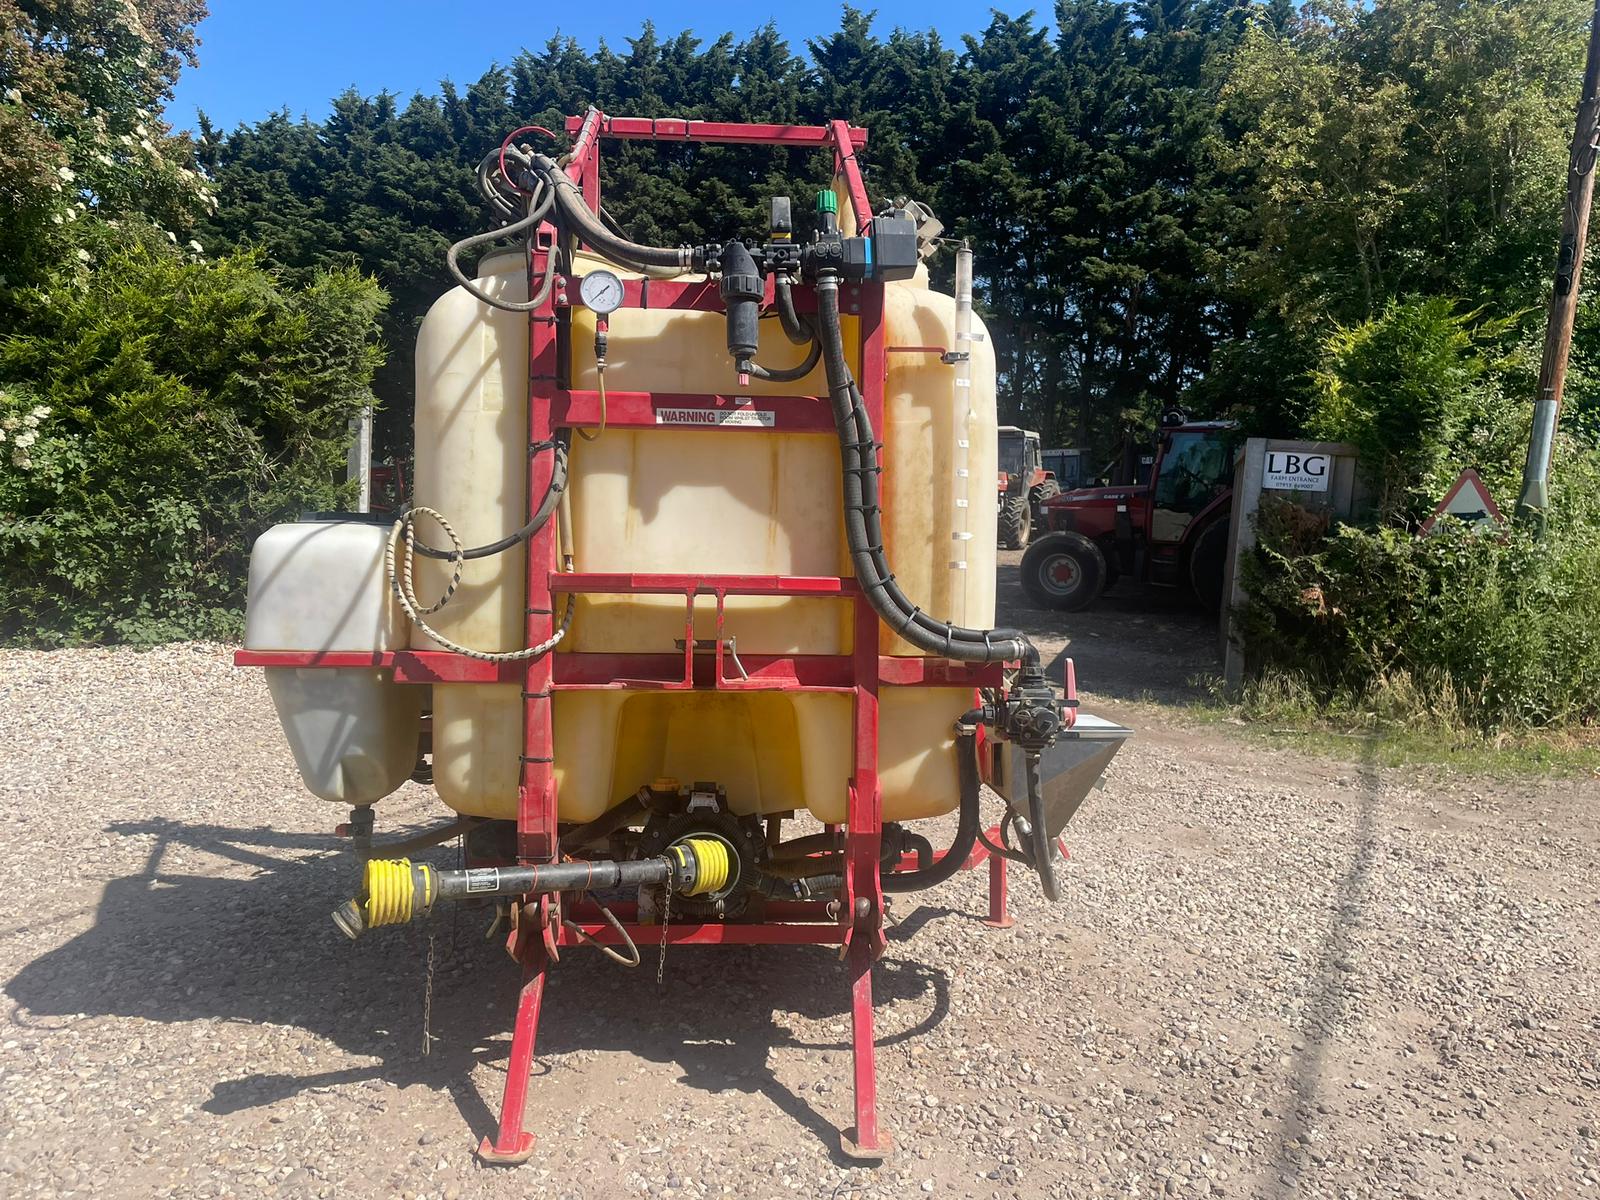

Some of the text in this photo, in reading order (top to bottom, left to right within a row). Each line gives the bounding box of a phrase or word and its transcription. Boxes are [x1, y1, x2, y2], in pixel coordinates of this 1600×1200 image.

[660, 410, 716, 423] WARNING
[1268, 454, 1325, 476] LBG
[1288, 475, 1320, 483] ENTRANCE
